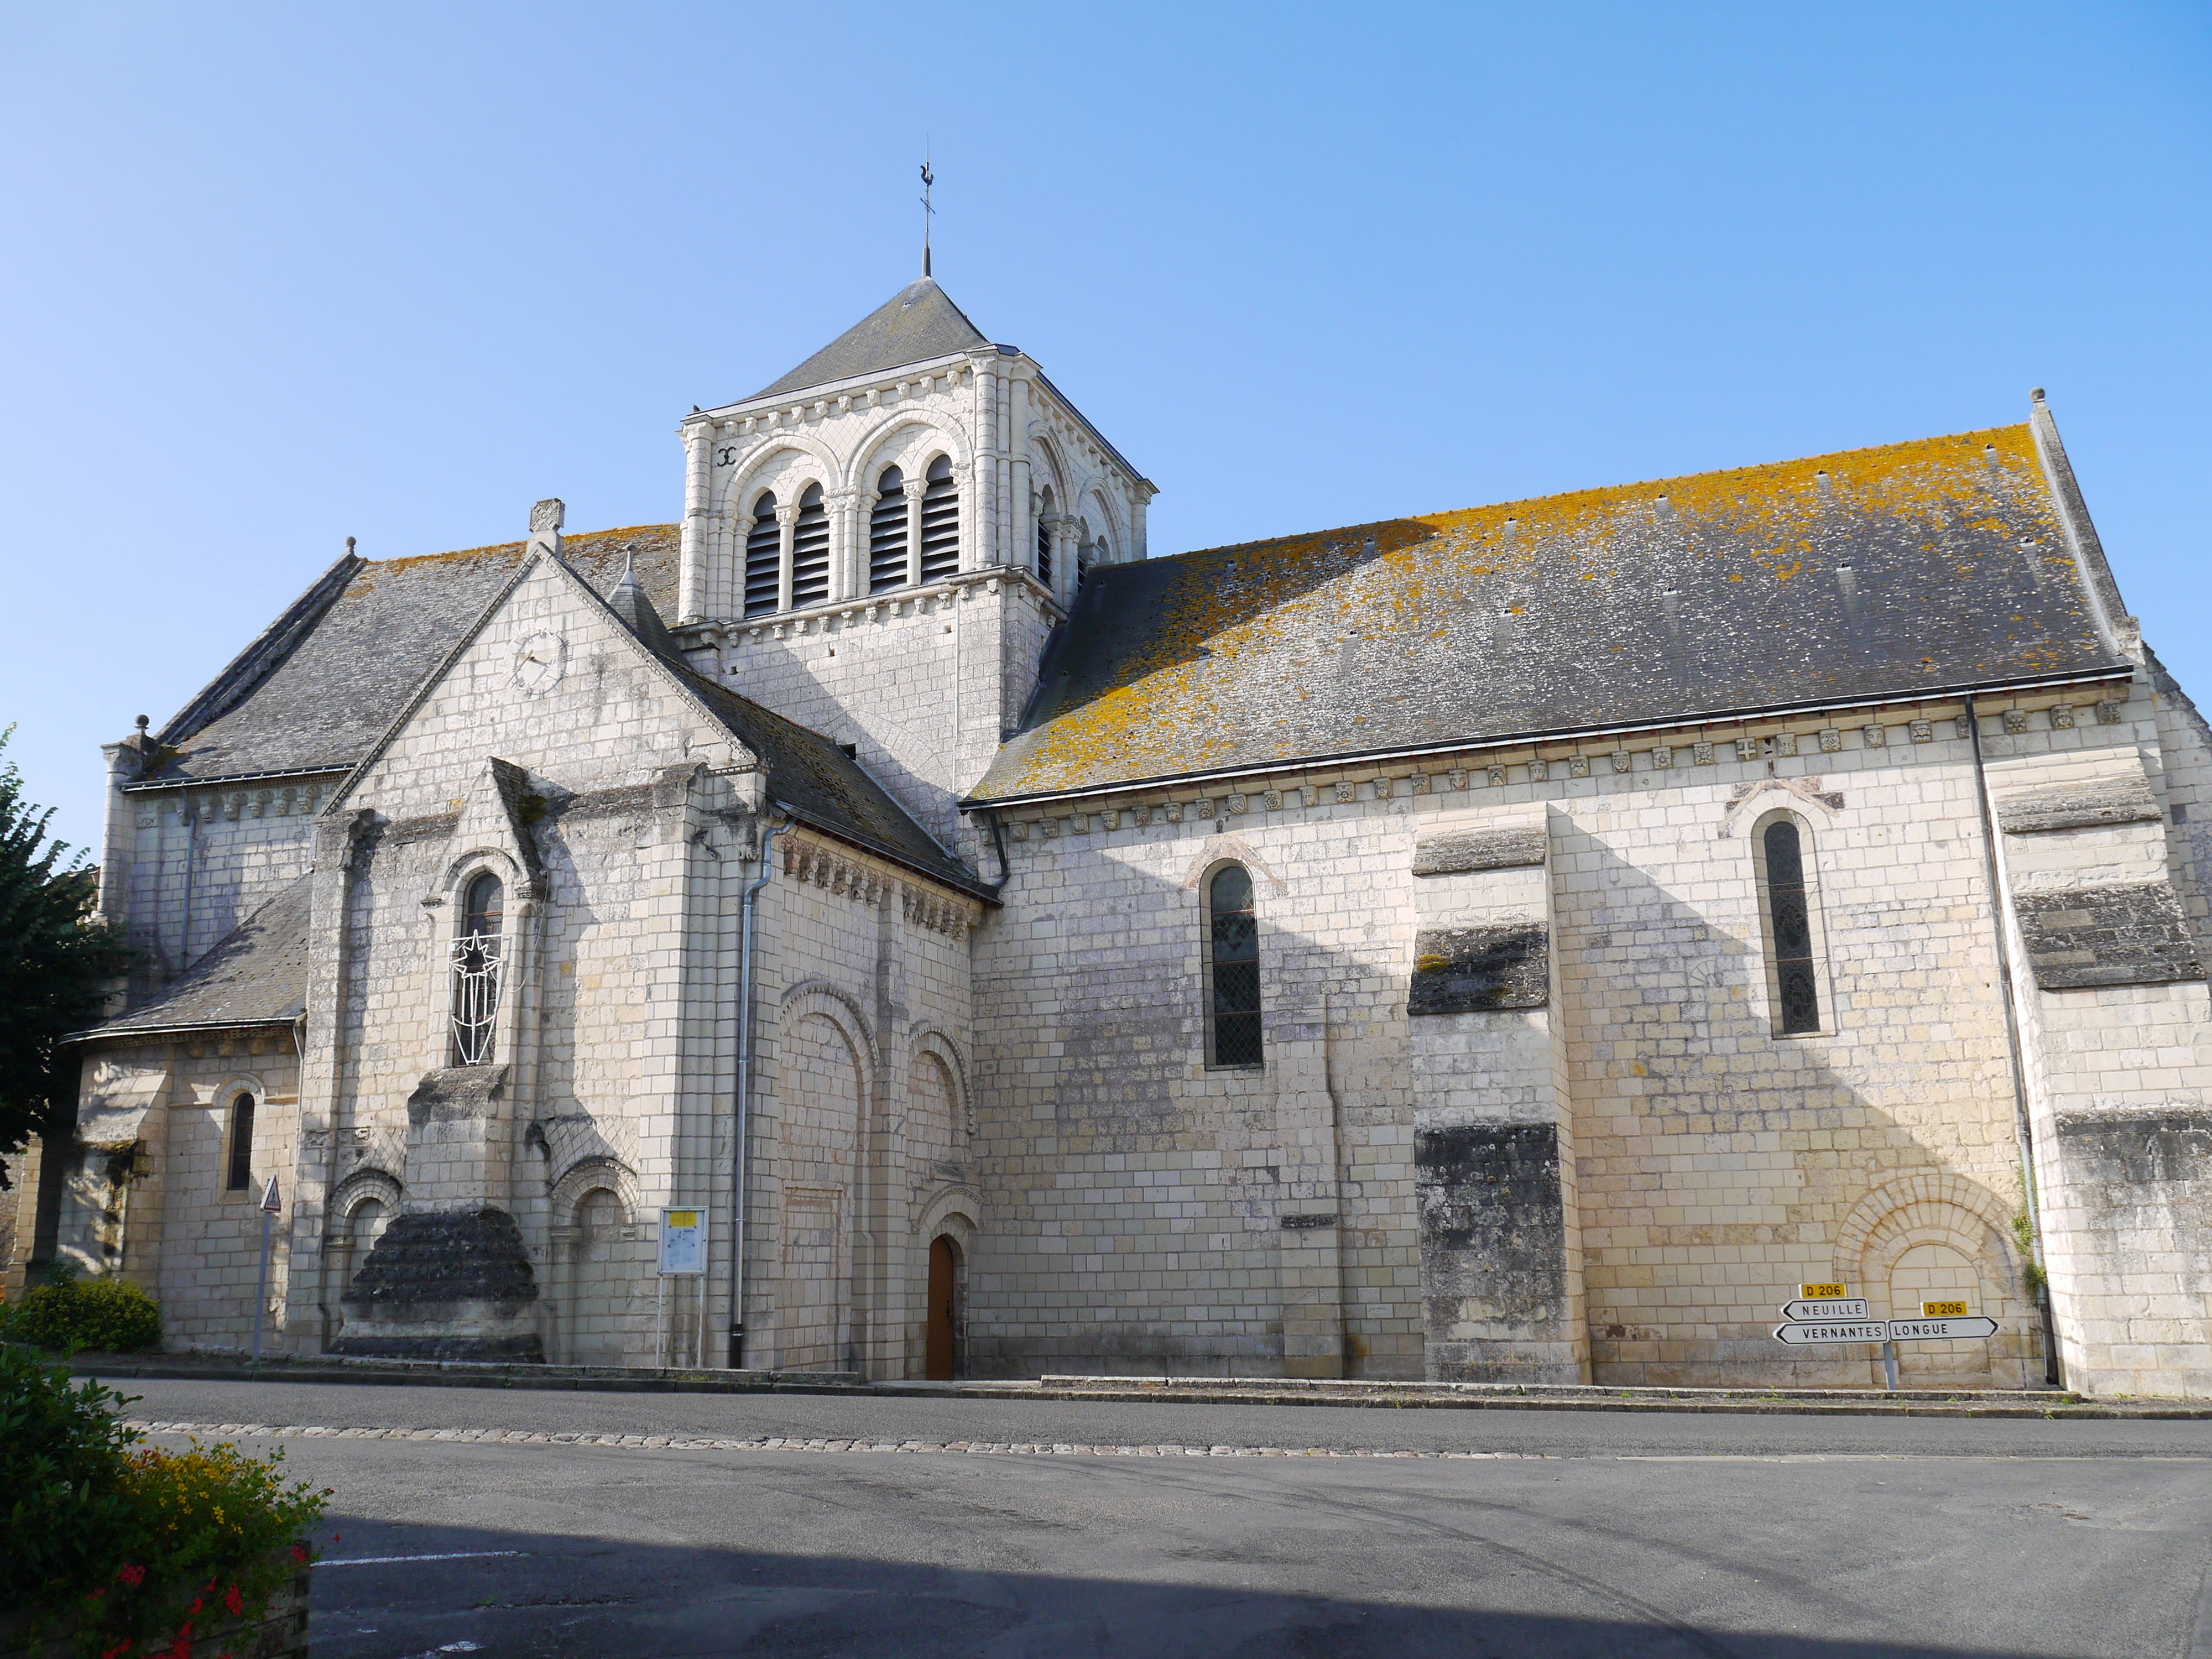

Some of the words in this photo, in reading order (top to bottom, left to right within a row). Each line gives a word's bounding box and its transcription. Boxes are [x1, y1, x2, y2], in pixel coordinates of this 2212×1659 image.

[1807, 1287, 1813, 1296] D
[1819, 1286, 1841, 1295] 206
[1928, 1305, 1936, 1314] D
[1940, 1303, 1963, 1313] 206
[1803, 1327, 1882, 1338] VERNANTES
[1895, 1324, 1948, 1335] LONGUE
